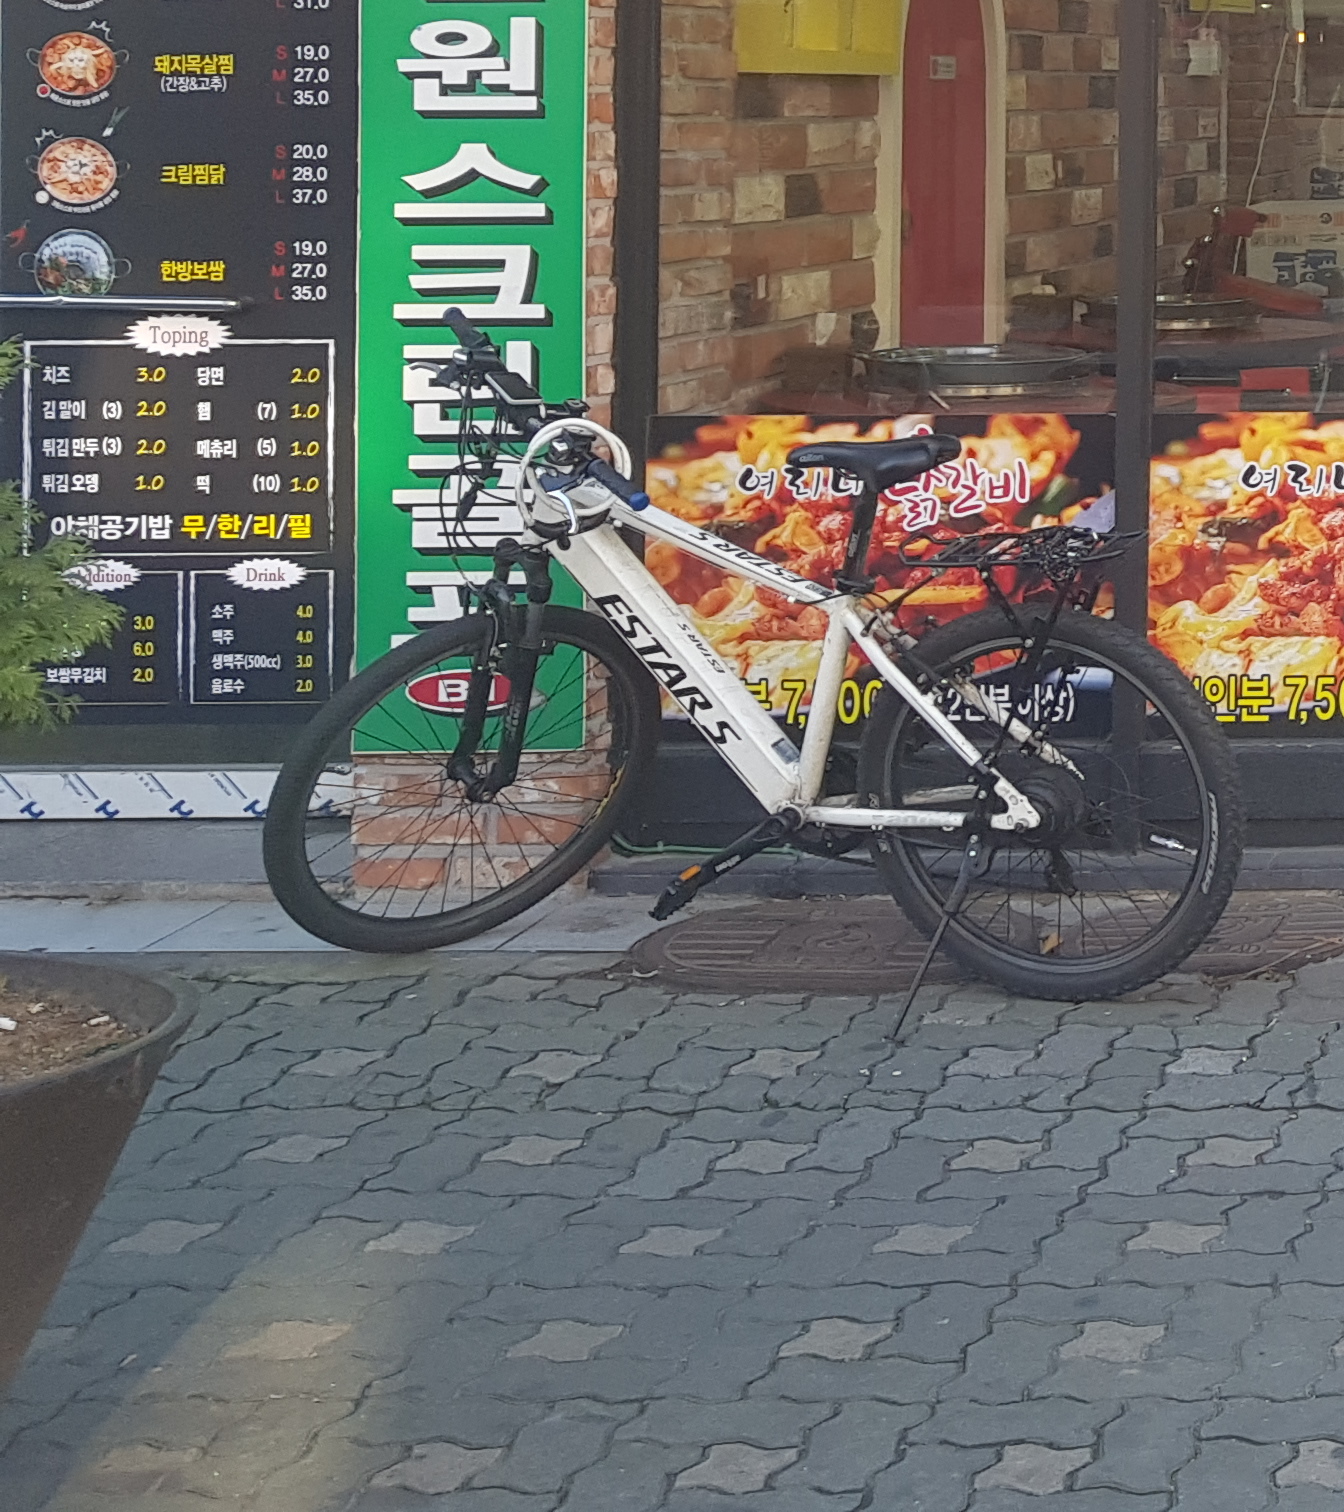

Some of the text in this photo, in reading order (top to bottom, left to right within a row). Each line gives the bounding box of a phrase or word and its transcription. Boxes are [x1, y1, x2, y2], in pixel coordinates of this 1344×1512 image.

[294, 45, 330, 61] 19.0
[154, 53, 235, 75] 돼지목살찜
[160, 76, 228, 93] (간장&고추)
[293, 68, 330, 84] 27.0
[293, 90, 330, 106] 35.0
[292, 144, 328, 161] 20.0
[160, 164, 227, 185] 크림찜닭
[292, 166, 328, 182] 28.0
[292, 189, 328, 205] 37.0
[292, 240, 328, 257] 19.0
[160, 260, 226, 282] 한방보쌈
[291, 263, 327, 279] 27.0
[291, 285, 327, 301] 35.0
[149, 325, 209, 346] Toping
[42, 365, 321, 386] 치즈 3.0 당면 2.0
[102, 401, 122, 422] (3)
[135, 400, 167, 418] 2.0
[257, 402, 277, 421] (7)
[290, 403, 321, 420] 1.0
[41, 437, 70, 458] 튀김
[71, 437, 100, 458] 만두
[102, 437, 122, 457] (3)
[135, 439, 167, 456] 2.0
[257, 437, 277, 457] (5)
[290, 440, 321, 457] 1.0
[41, 473, 70, 494] 튀김
[70, 473, 99, 494] 오뎅
[134, 475, 165, 492] 1.0
[253, 474, 281, 494] (10)
[289, 476, 321, 493] 1.0
[246, 567, 286, 583] Drink
[211, 604, 314, 621] 소주 4.0
[133, 615, 155, 631] 3.0
[211, 629, 314, 645] 맥주 4.0
[132, 641, 155, 657] 6.0
[296, 655, 314, 669] 3.0
[592, 593, 743, 745] ESTARS
[46, 667, 155, 684] 보쌈무김치 2.0
[296, 679, 314, 693] 2.0
